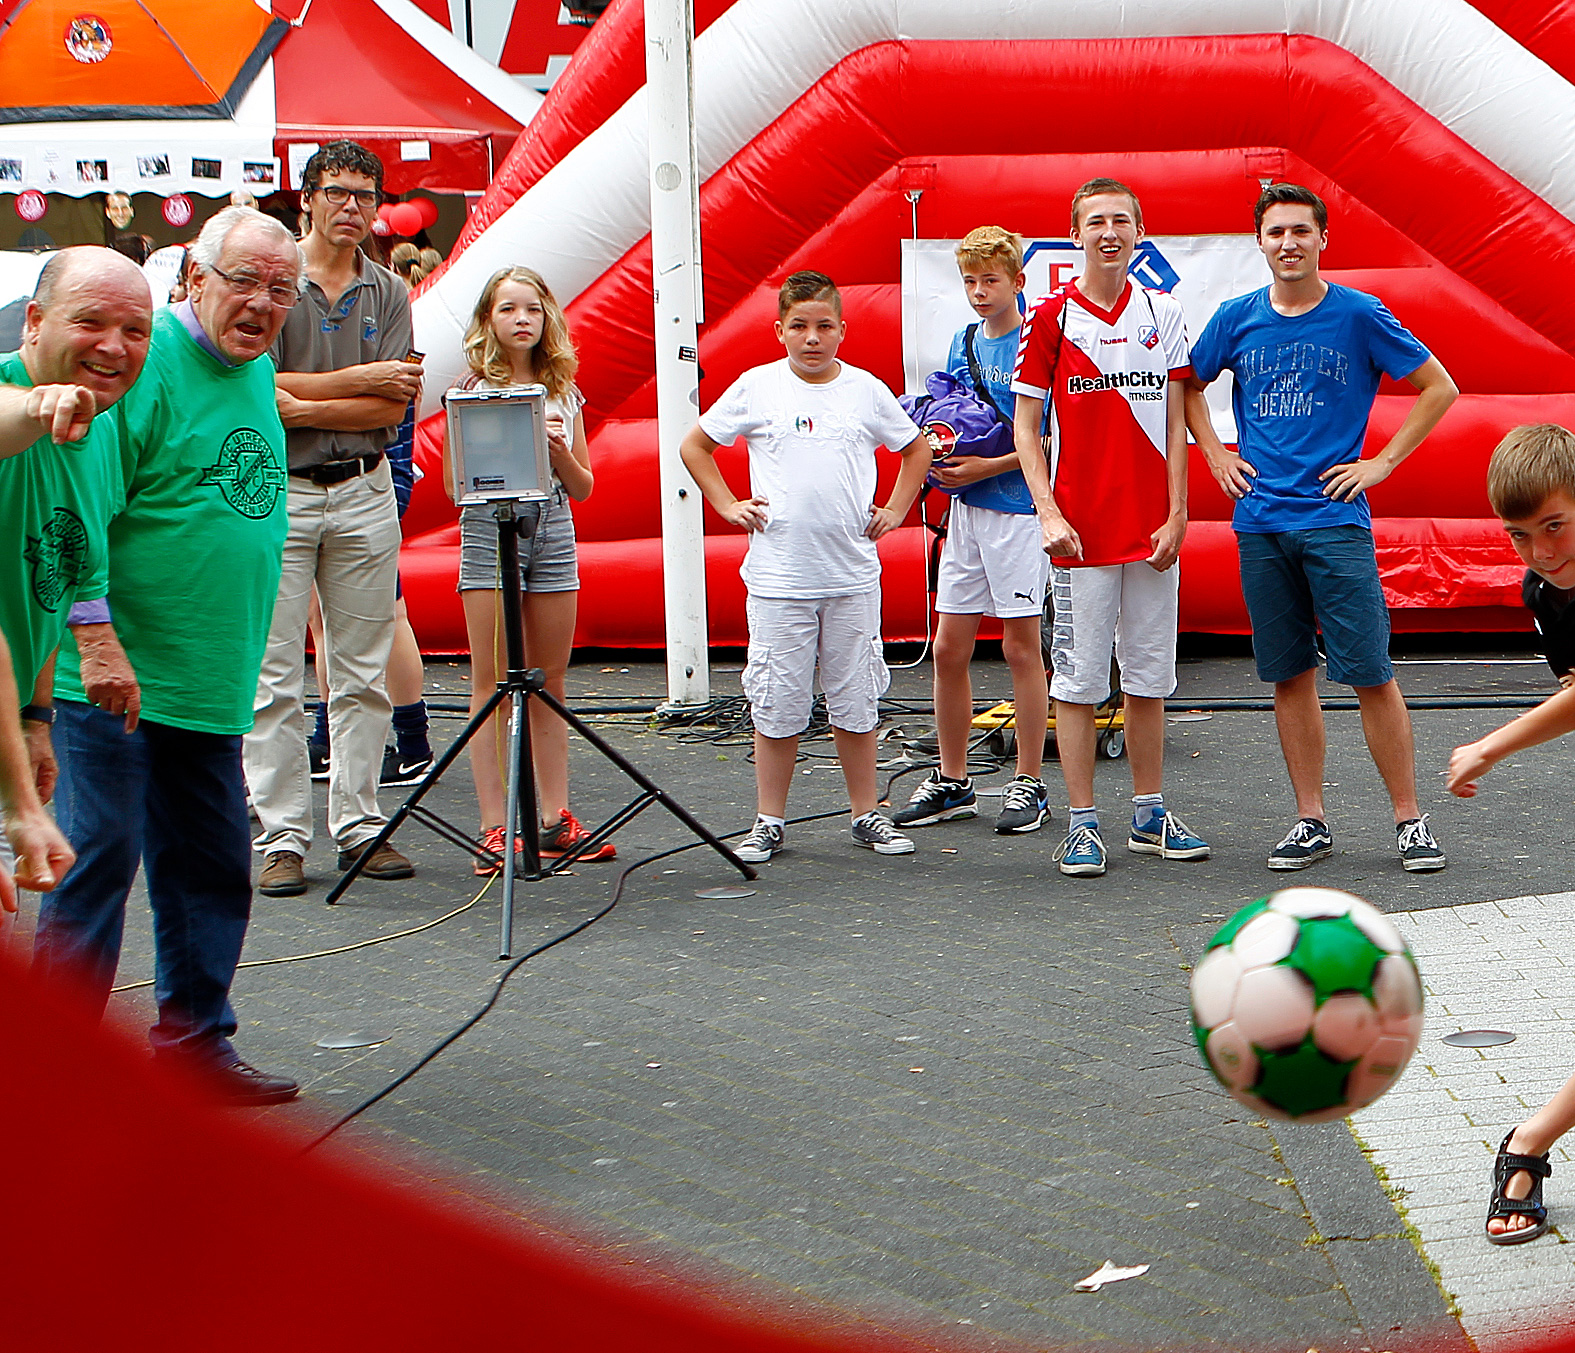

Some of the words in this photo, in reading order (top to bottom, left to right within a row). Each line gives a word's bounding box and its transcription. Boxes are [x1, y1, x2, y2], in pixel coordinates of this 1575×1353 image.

[1240, 342, 1349, 385] HILFIGER
[1069, 371, 1167, 393] HealthCity
[1271, 372, 1302, 391] 1985
[1129, 392, 1164, 402] FITNESS
[232, 432, 272, 460] UTRECHT
[230, 494, 256, 515] OPEN
[54, 512, 85, 549] TRECHT
